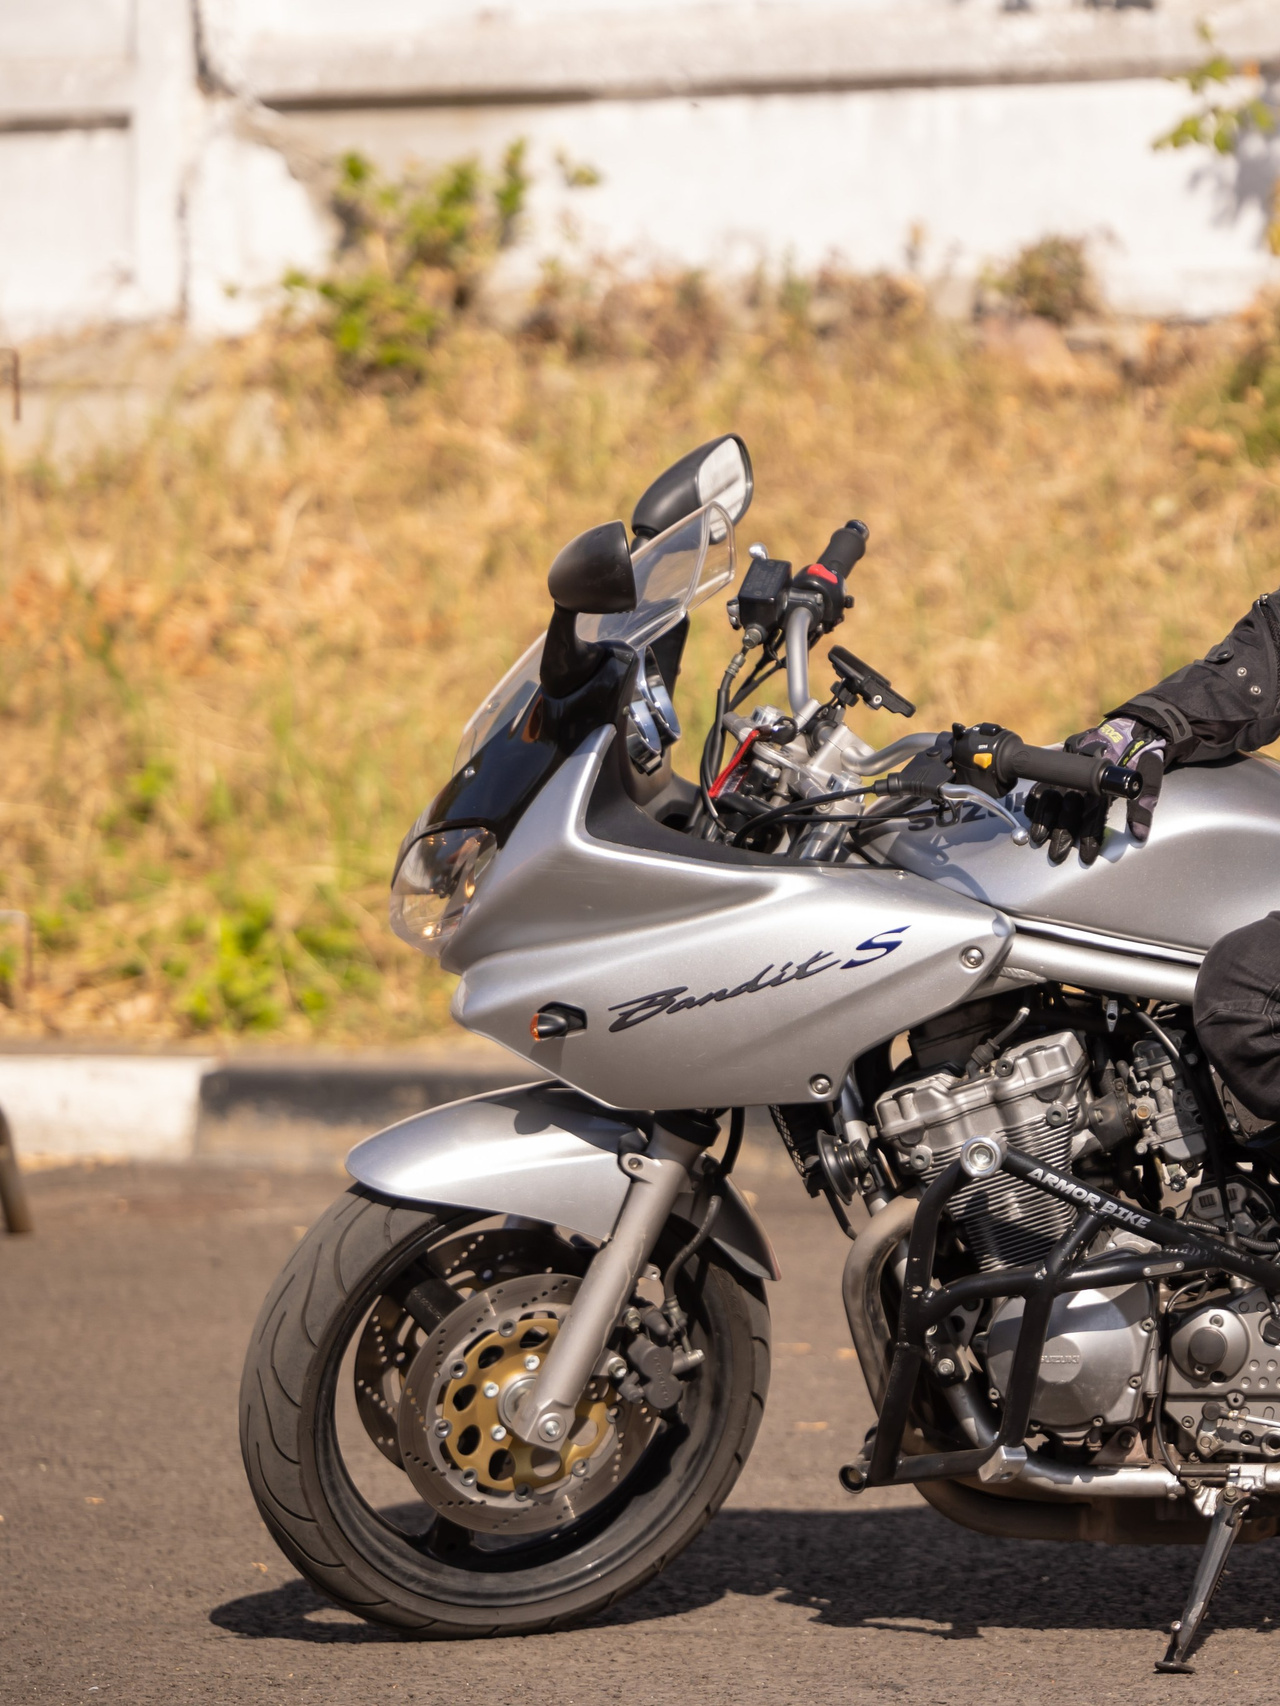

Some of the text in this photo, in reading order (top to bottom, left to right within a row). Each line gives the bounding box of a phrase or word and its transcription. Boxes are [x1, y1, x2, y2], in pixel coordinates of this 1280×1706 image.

[607, 924, 912, 1033] Bandit S
[1026, 1167, 1151, 1229] ARMOR BIKE
